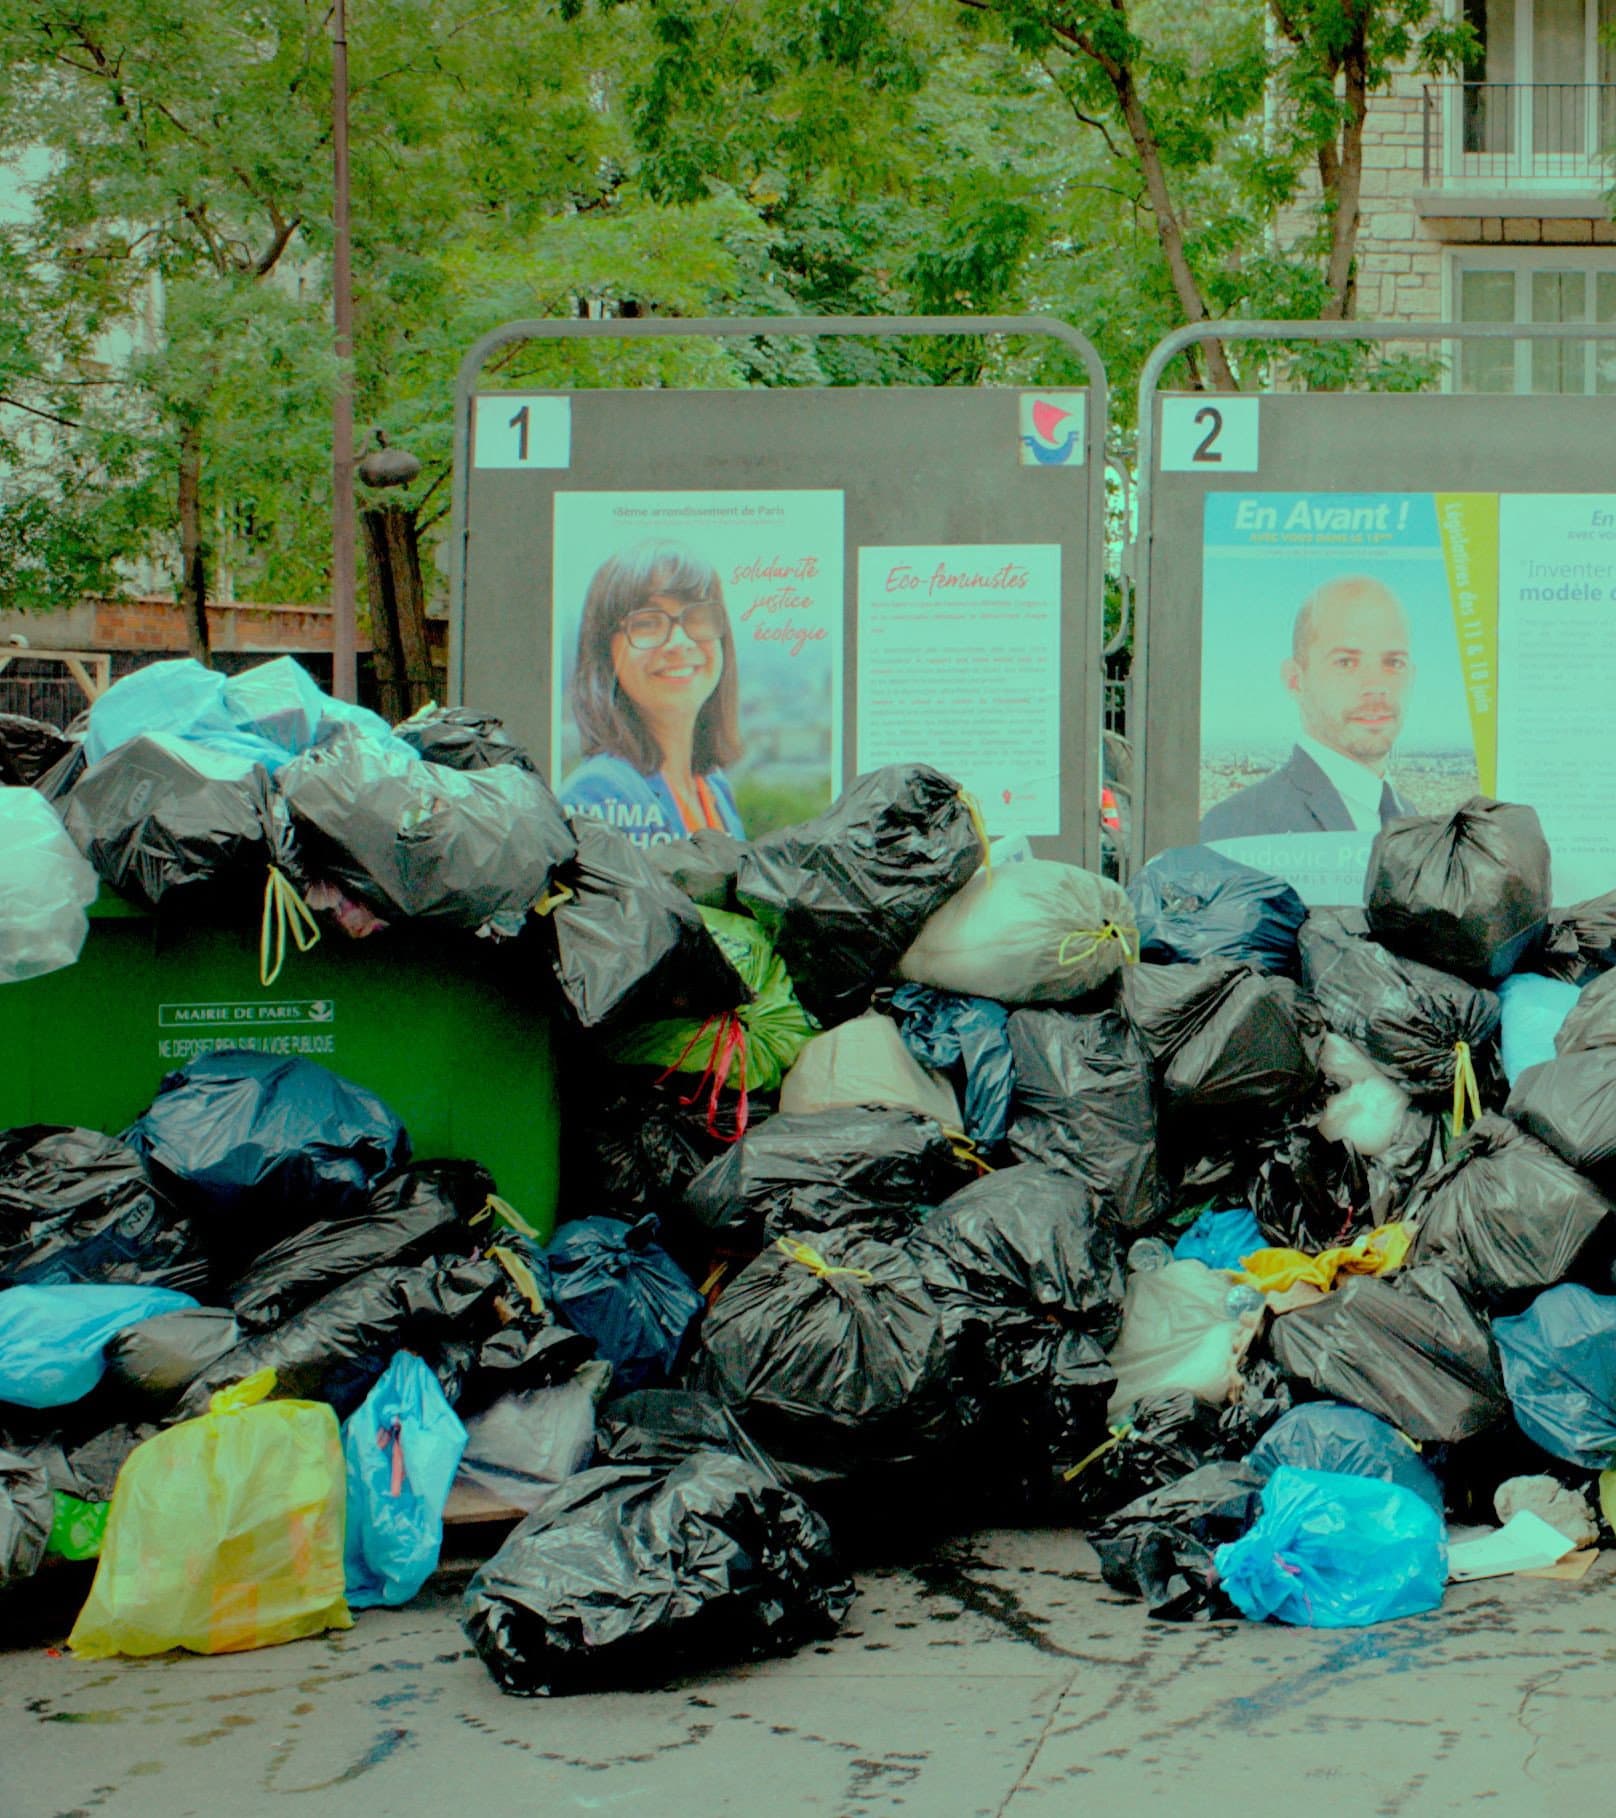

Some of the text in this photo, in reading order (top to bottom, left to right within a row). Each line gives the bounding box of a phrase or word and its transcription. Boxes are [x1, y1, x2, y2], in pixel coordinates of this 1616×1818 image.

[508, 406, 529, 460] 1
[1192, 407, 1224, 462] 2
[652, 505, 738, 516] arrondissement
[742, 504, 754, 516] de
[758, 504, 785, 515] Paris
[1235, 499, 1276, 530] En
[1284, 499, 1390, 531] Avant
[1591, 510, 1614, 527] En
[731, 555, 820, 584] solidarité
[740, 586, 813, 621] justice
[1519, 583, 1602, 602] modèle
[753, 619, 828, 656] écologie
[174, 1006, 302, 1021] MAIRIE DE PARIS
[158, 1039, 171, 1057] NE
[292, 1034, 335, 1053] PUBLIQUE
